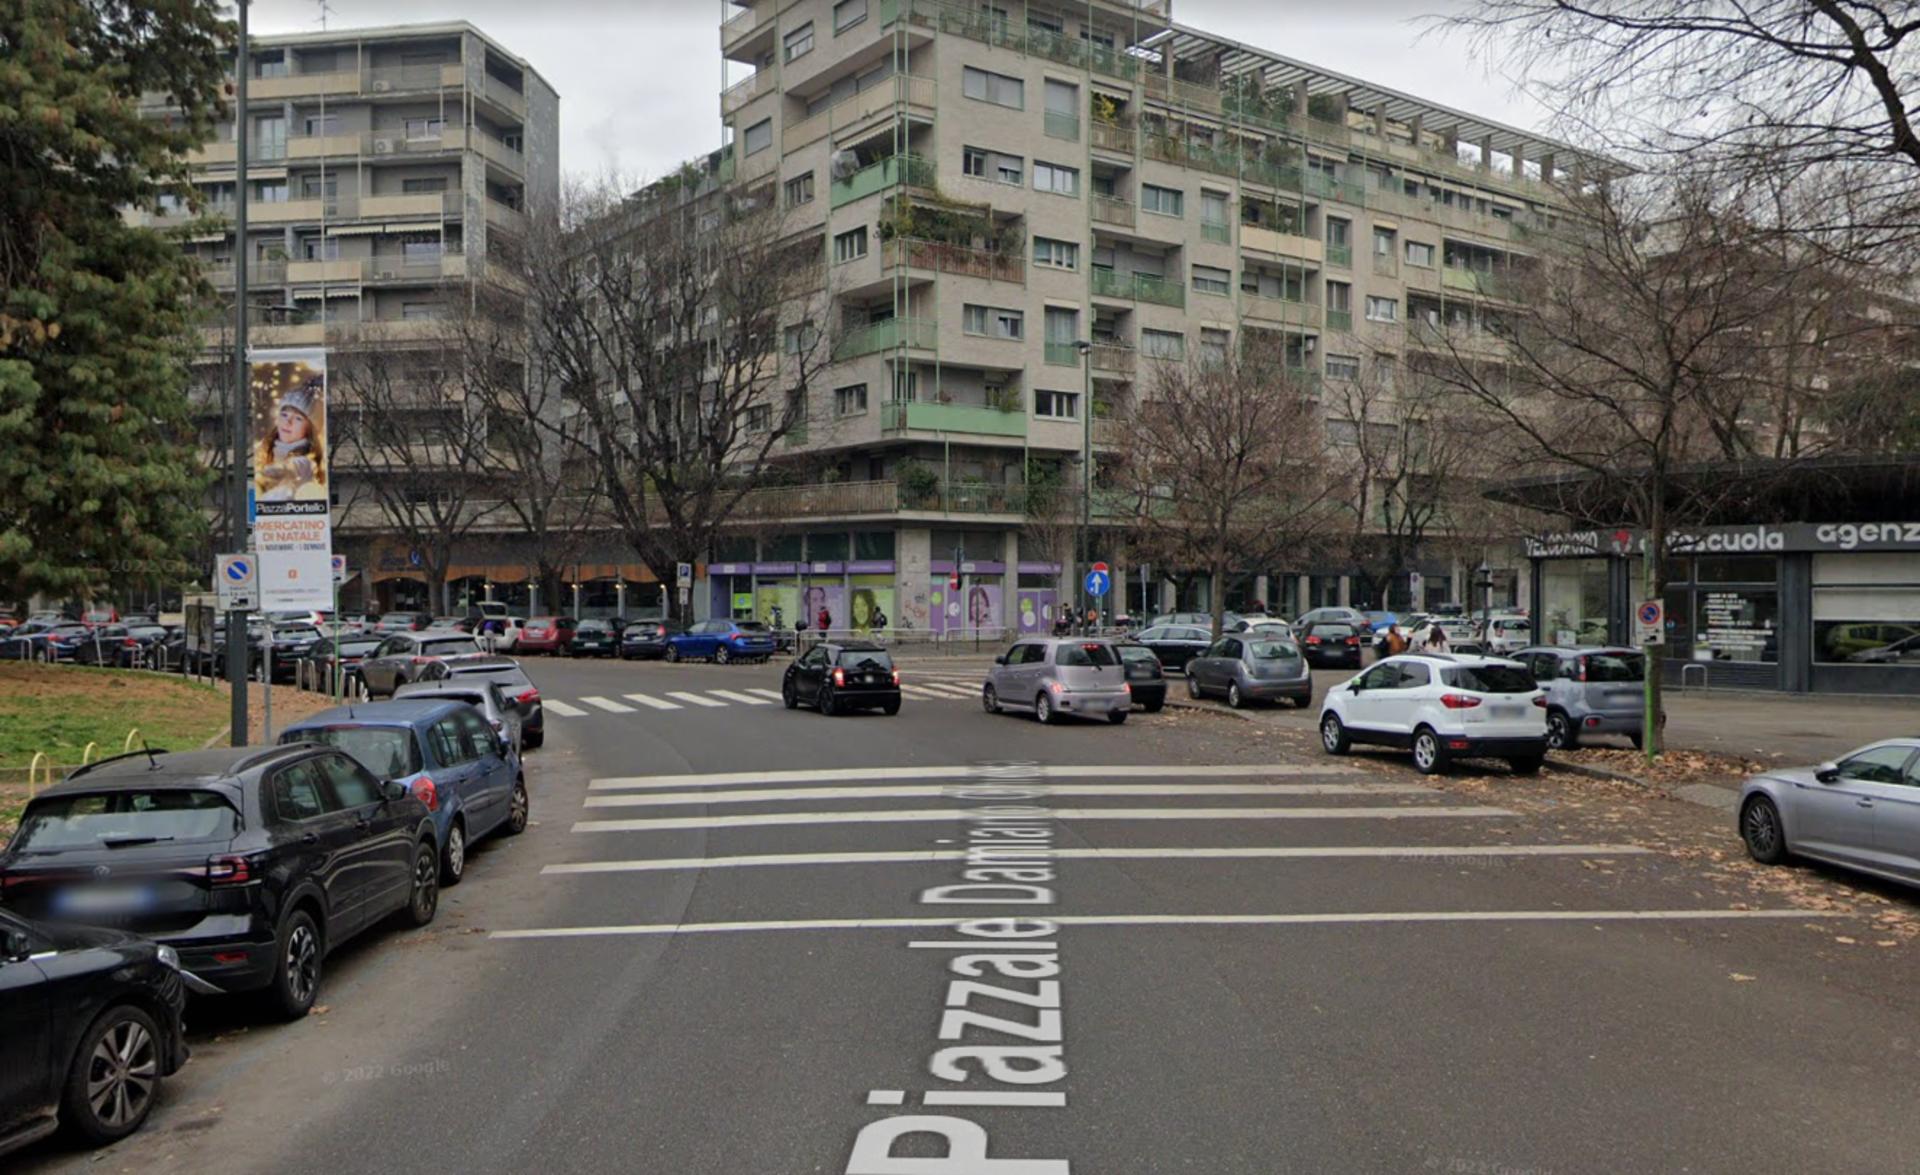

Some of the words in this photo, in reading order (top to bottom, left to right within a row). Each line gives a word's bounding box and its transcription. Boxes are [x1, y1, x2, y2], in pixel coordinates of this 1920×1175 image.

[256, 520, 326, 531] MERCATINO
[262, 533, 275, 542] DI
[276, 531, 321, 541] NATALE
[1816, 523, 1920, 549] agenz
